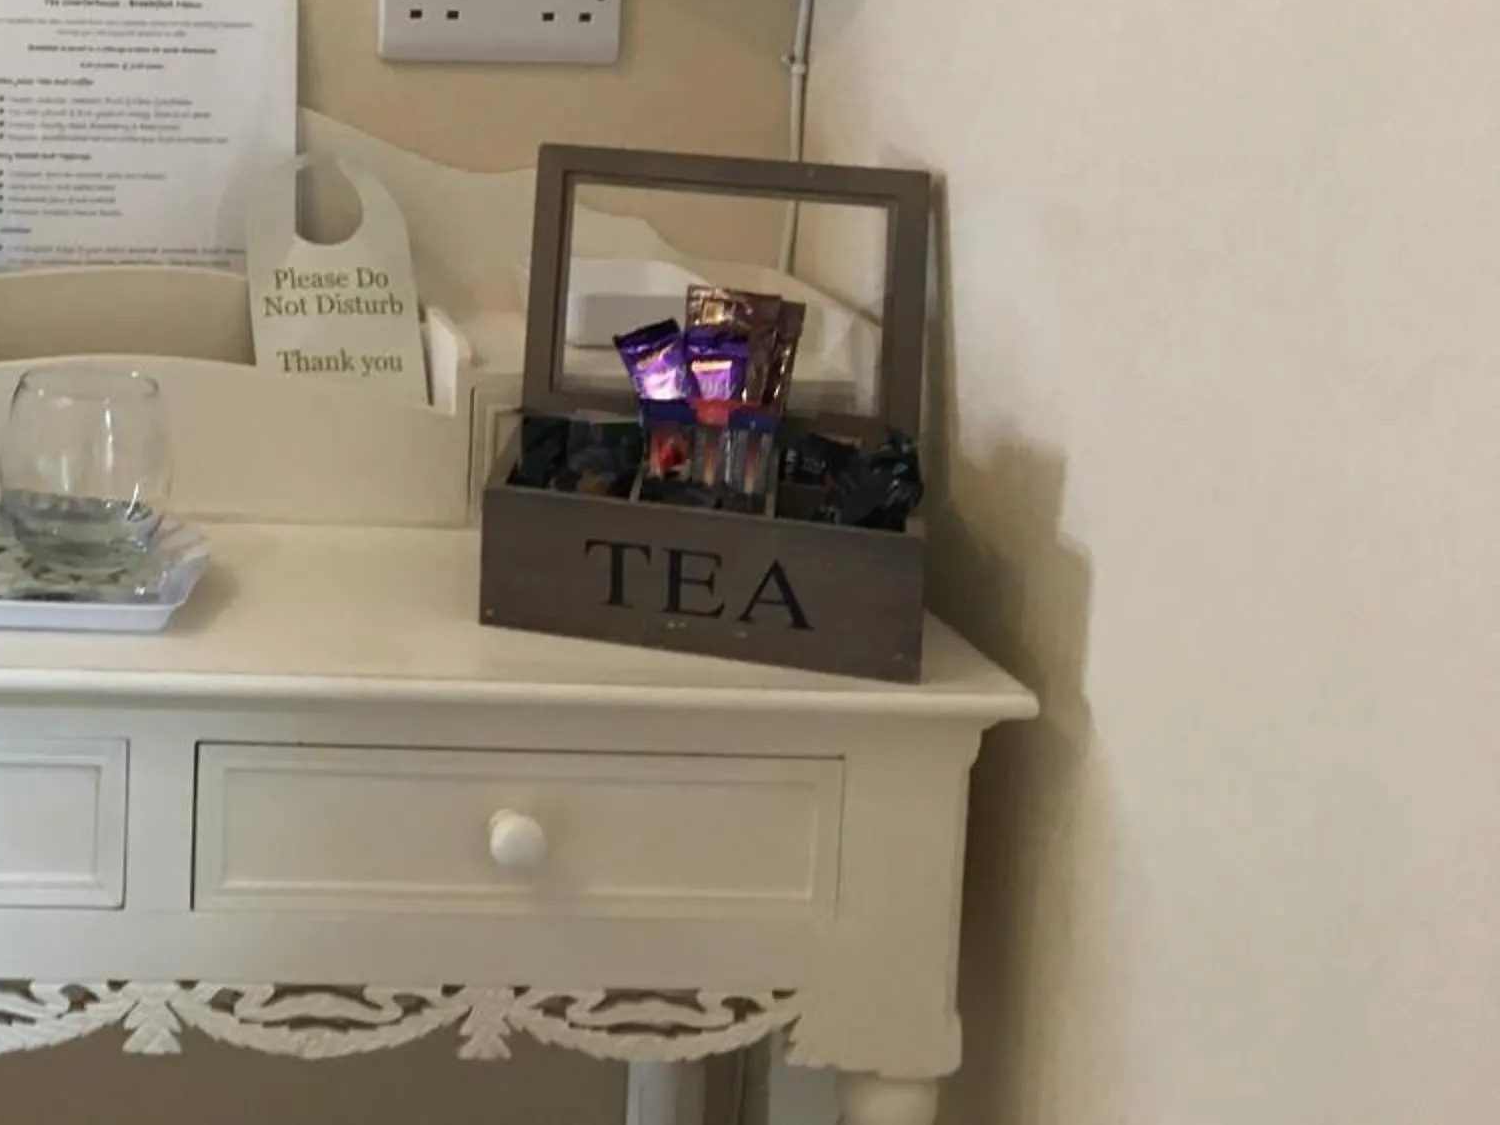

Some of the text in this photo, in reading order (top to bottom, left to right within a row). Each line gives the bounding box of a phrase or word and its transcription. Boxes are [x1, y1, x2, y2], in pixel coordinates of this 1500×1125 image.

[274, 266, 389, 290] Please Do
[263, 292, 404, 317] Not Disturb
[276, 347, 404, 377] Thank you
[584, 537, 815, 631] TEA
